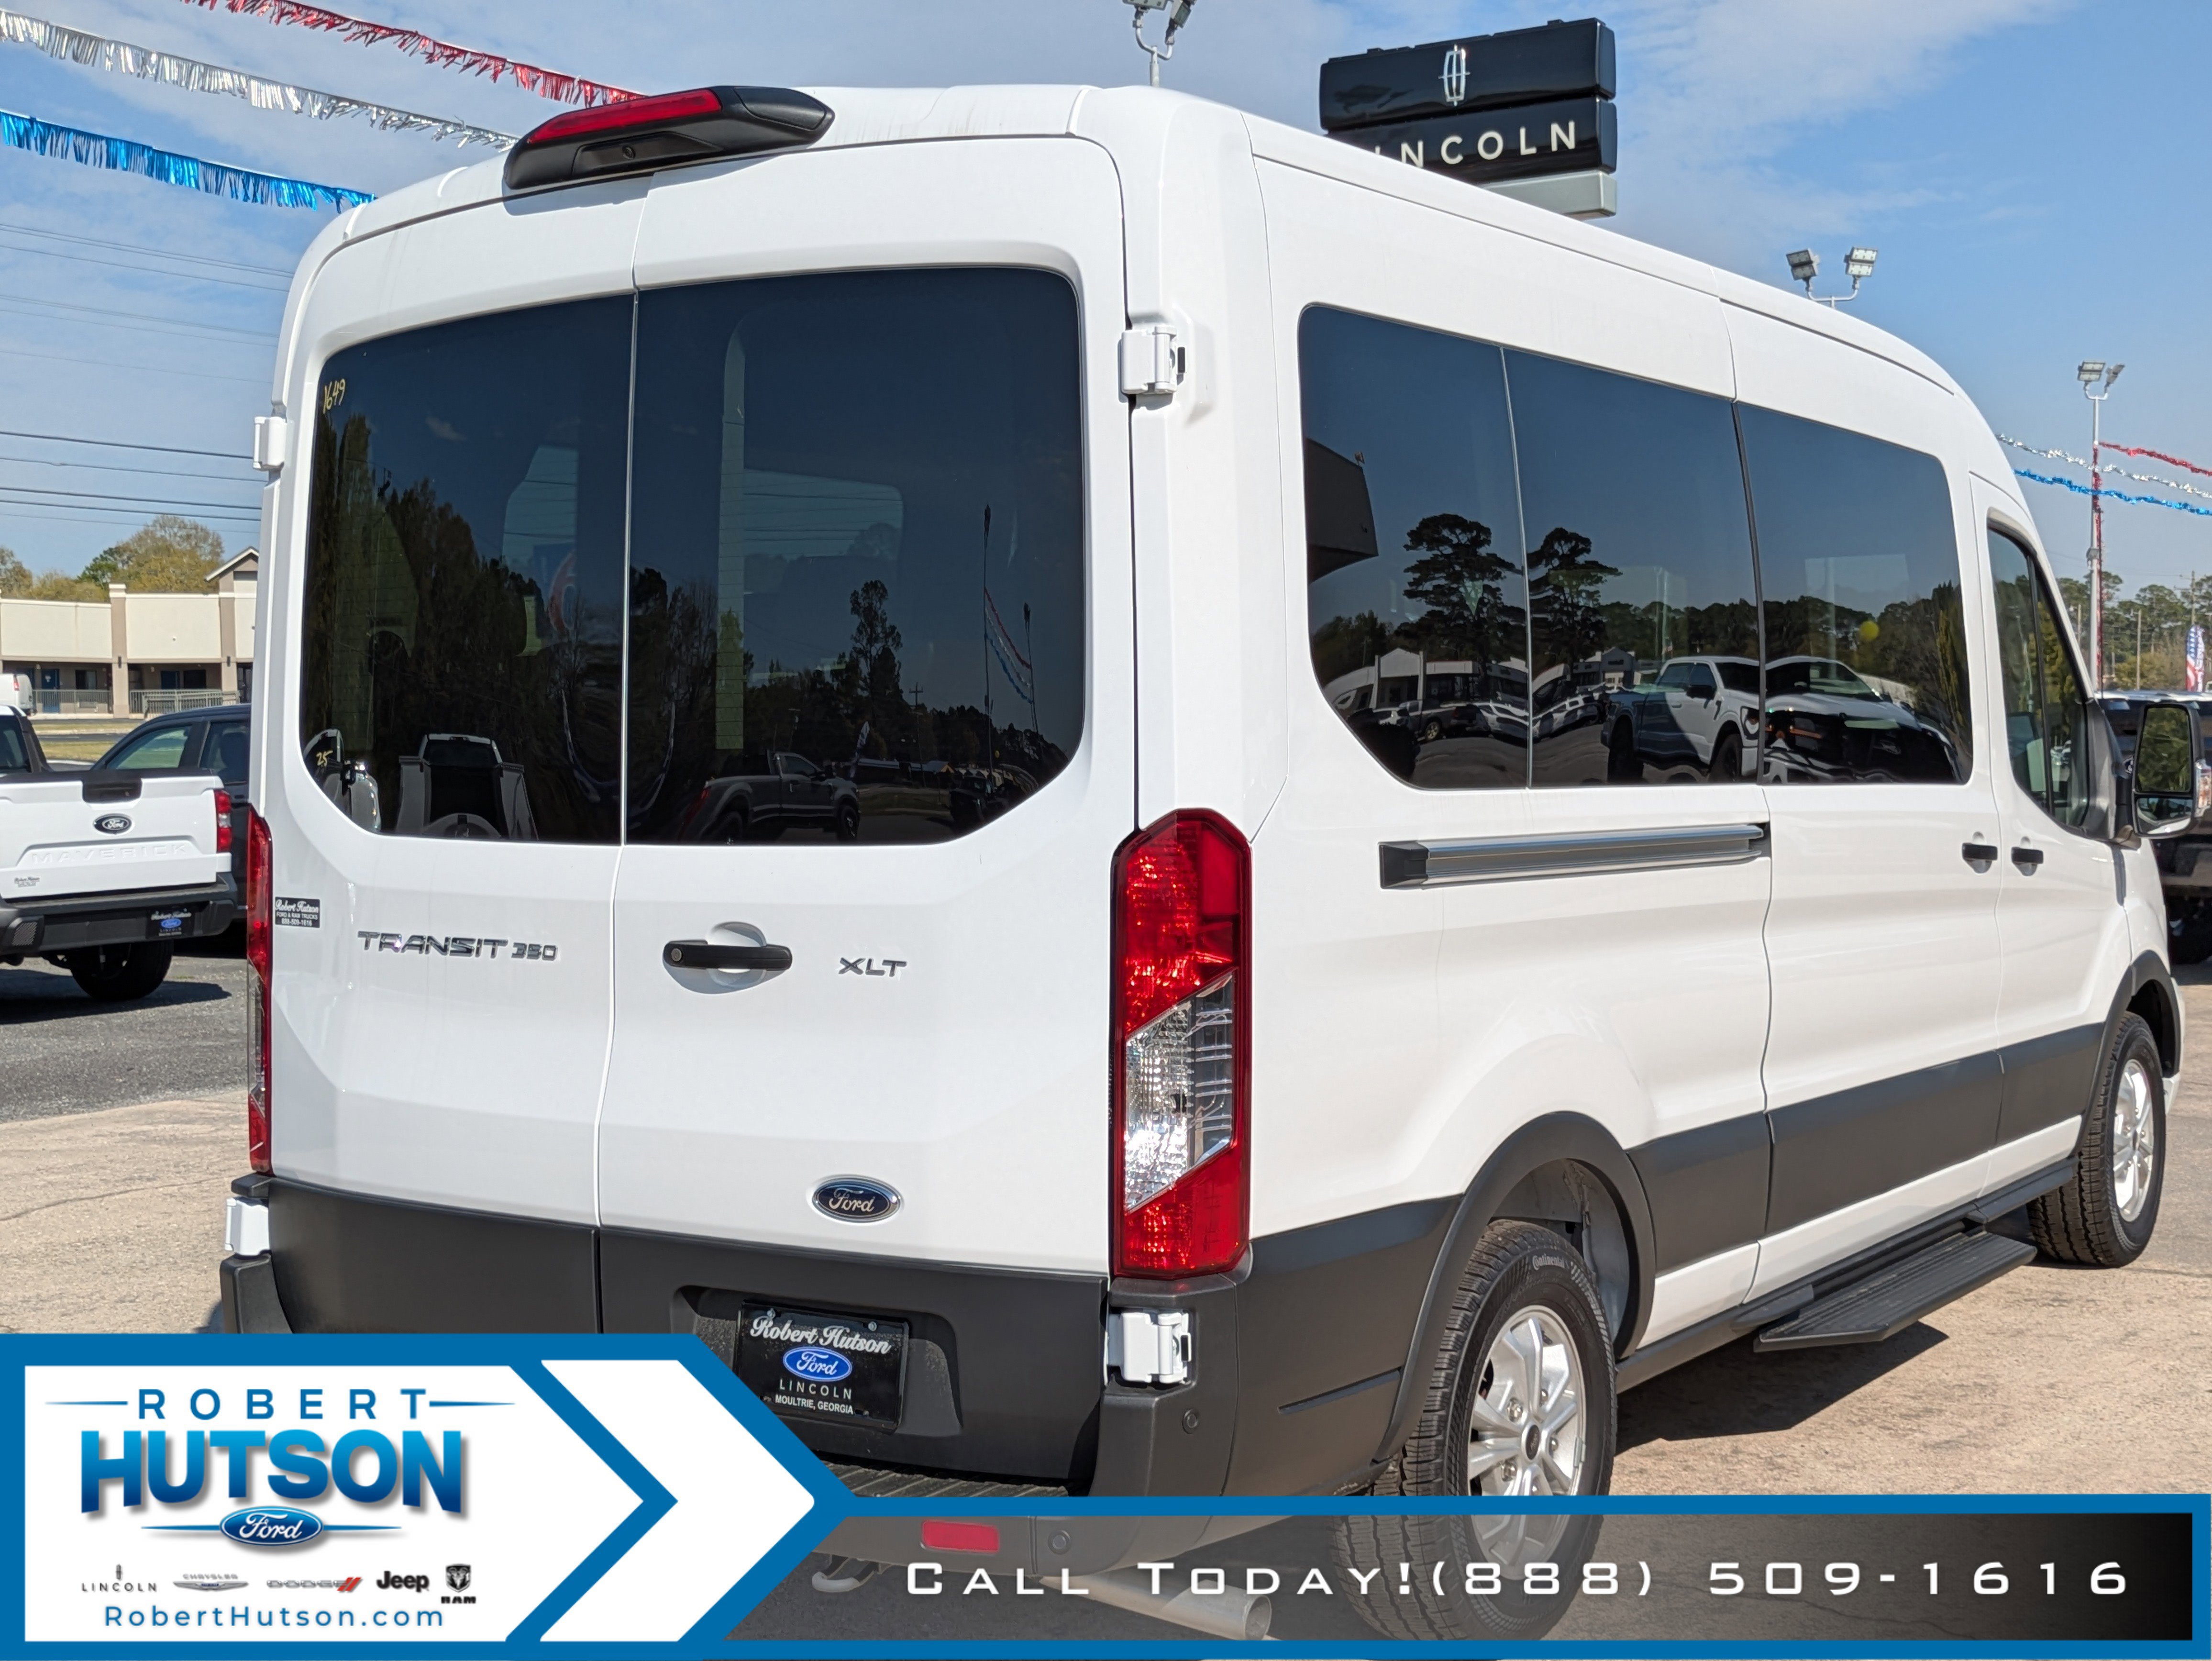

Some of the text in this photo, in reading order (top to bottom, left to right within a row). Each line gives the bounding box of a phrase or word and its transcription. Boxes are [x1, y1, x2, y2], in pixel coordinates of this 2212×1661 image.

[1375, 120, 1575, 168] NCOLN
[32, 844, 186, 864] MAVERICK
[358, 930, 559, 961] TRANSIT 350
[838, 957, 907, 977] XLT
[829, 1188, 876, 1212] Ford
[1532, 1253, 1565, 1271] Continental
[750, 1316, 892, 1354] Robert Hutson
[796, 1351, 839, 1375] Ford
[779, 1378, 852, 1400] LINCOLN
[775, 1394, 853, 1415] MOULTRIE, GEORGIA
